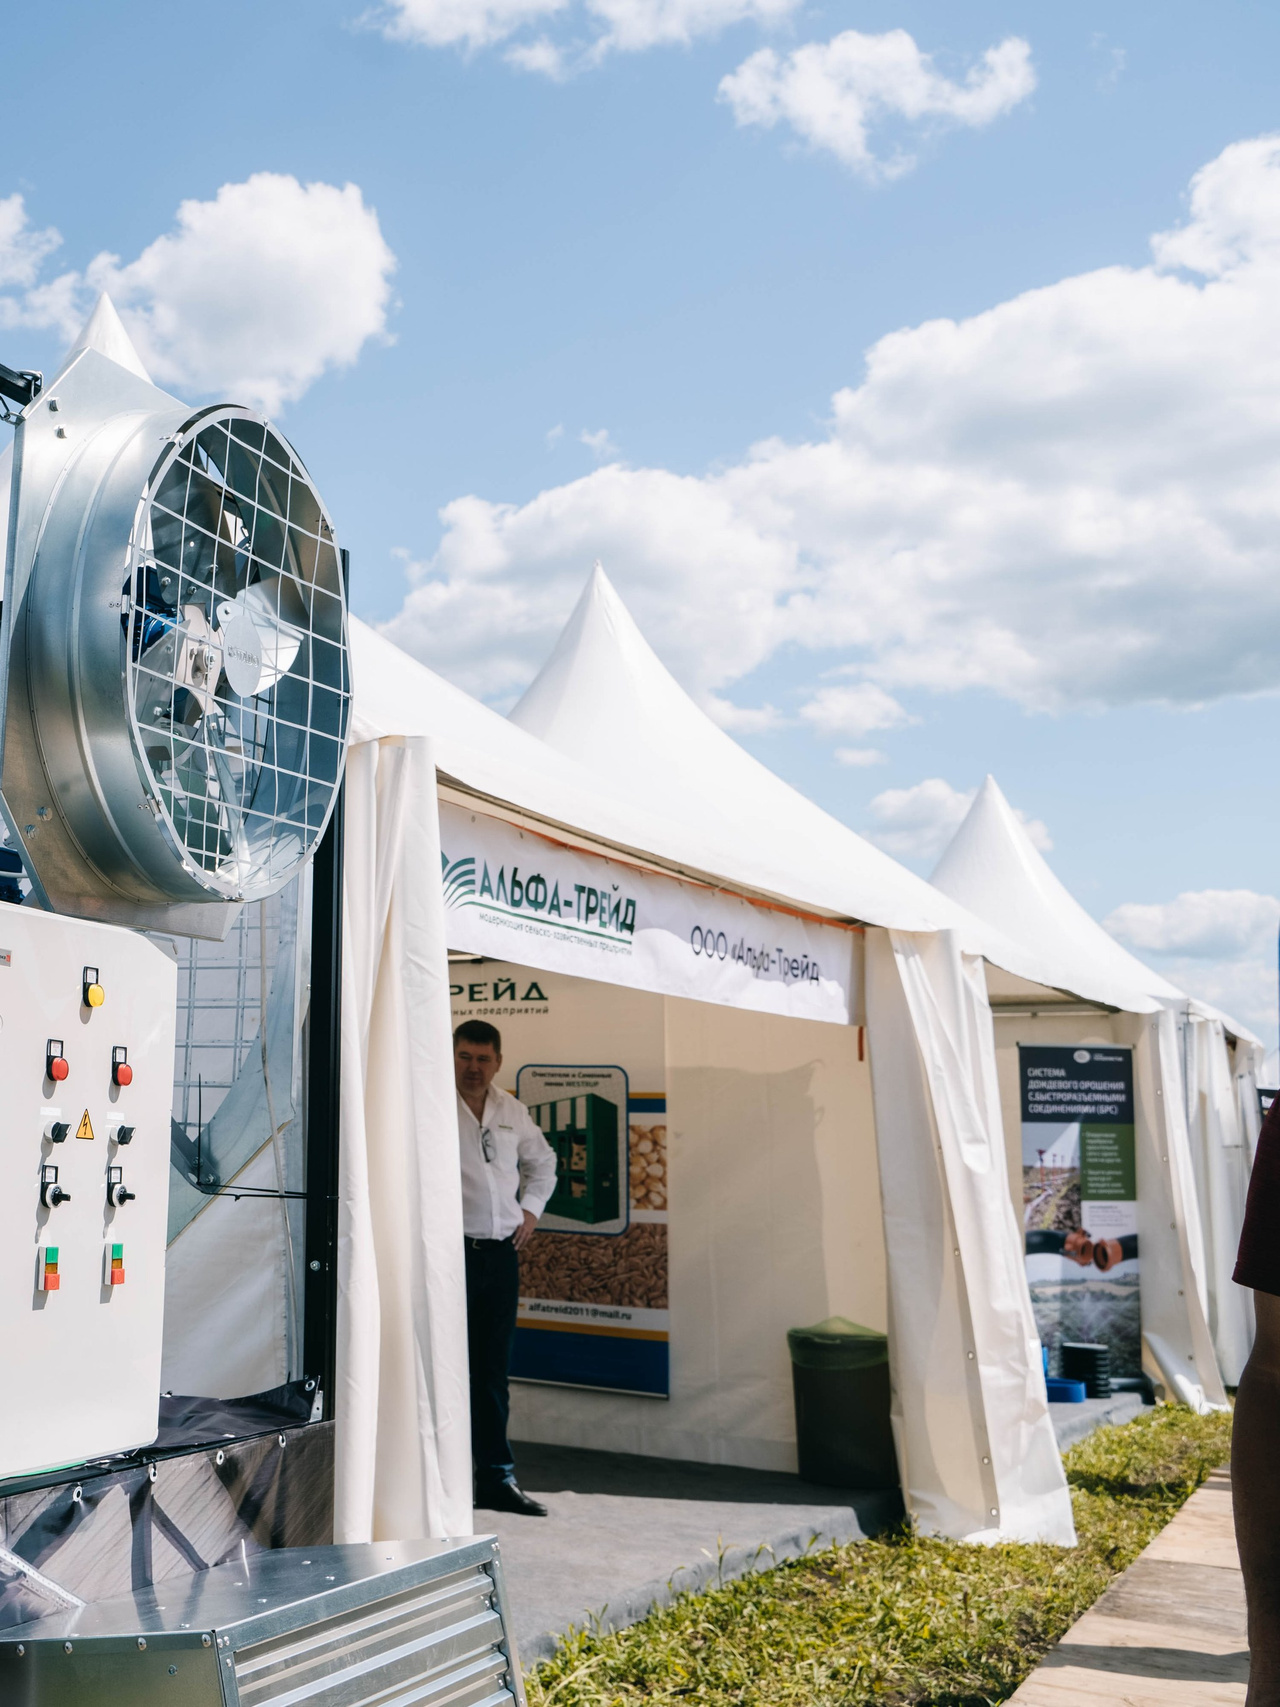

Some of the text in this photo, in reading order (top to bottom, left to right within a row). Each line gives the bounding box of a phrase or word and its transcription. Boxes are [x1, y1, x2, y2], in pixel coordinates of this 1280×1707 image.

[479, 858, 636, 936] АЛЬФА-ТРЕЙД
[691, 925, 728, 961] ООО
[476, 1006, 549, 1017] предприятий
[1027, 1067, 1066, 1077] СИСТЕМА
[1027, 1080, 1125, 1091] ДОЖДЕВОГО ОРОШЕНИЯ
[1028, 1104, 1119, 1115] СОЕДИНЕНИЯМИ (БРС)
[528, 1302, 632, 1321] alfatreid2011@mail.ru
